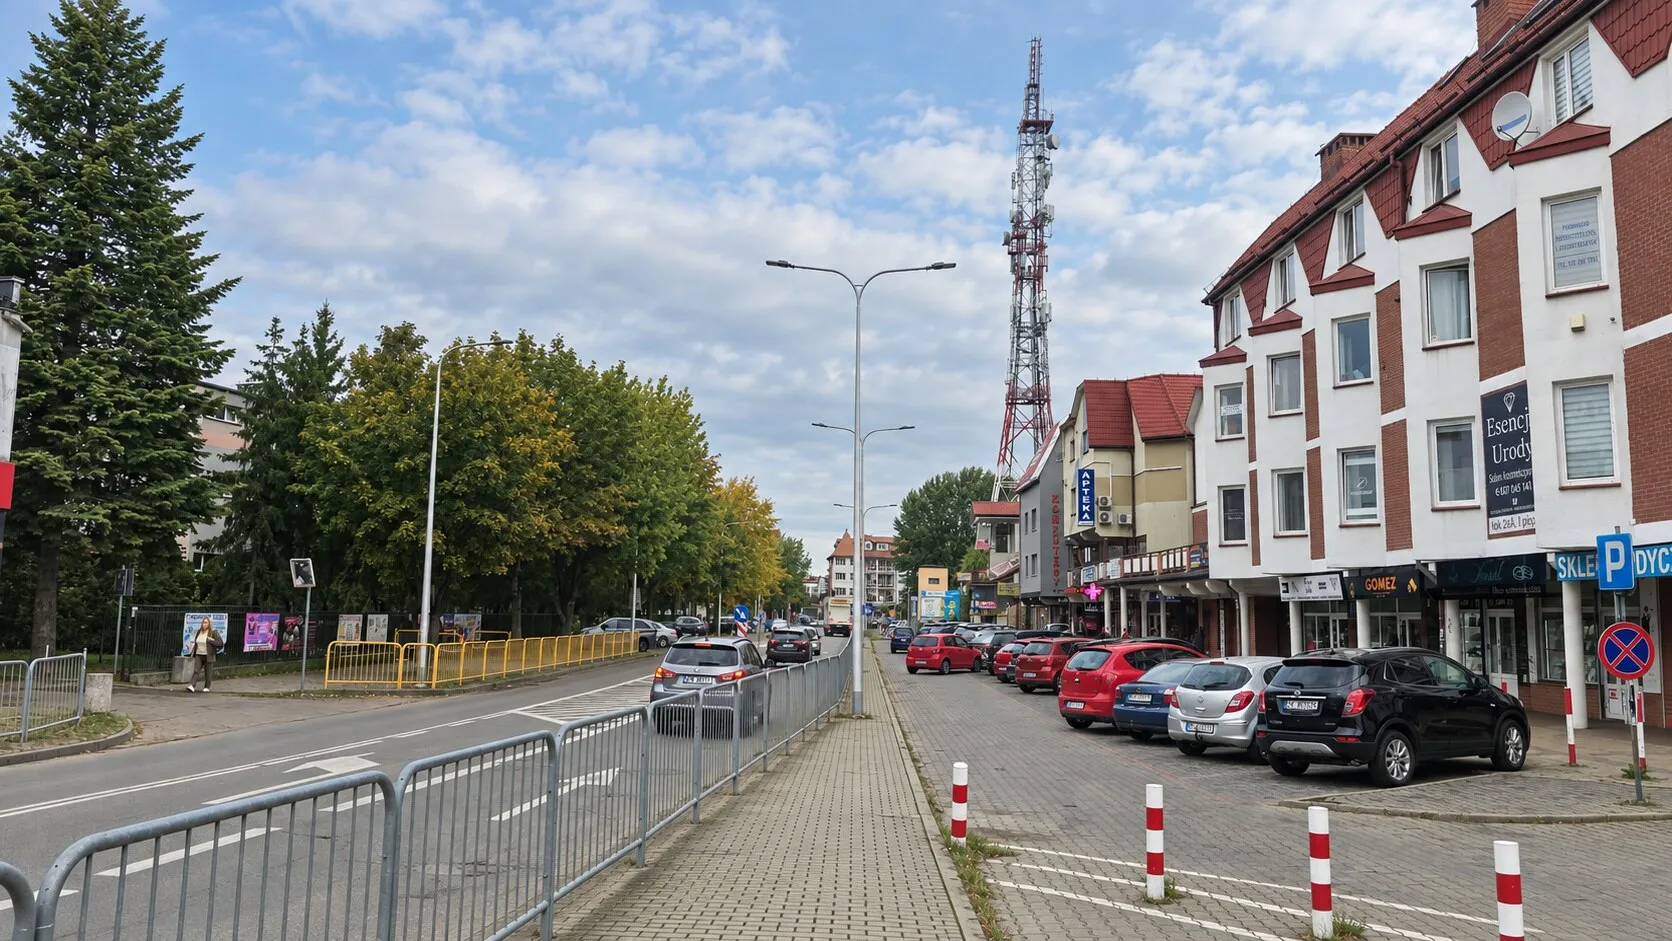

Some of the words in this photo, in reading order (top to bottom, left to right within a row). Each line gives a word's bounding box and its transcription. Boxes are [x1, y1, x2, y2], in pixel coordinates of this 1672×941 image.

[1492, 438, 1532, 464] Urody
[1081, 471, 1091, 520] APTEKA
[1558, 554, 1598, 579] SKLE
[1633, 547, 1672, 575] DYC
[1604, 540, 1626, 583] P
[1364, 576, 1397, 591] GOMEZ
